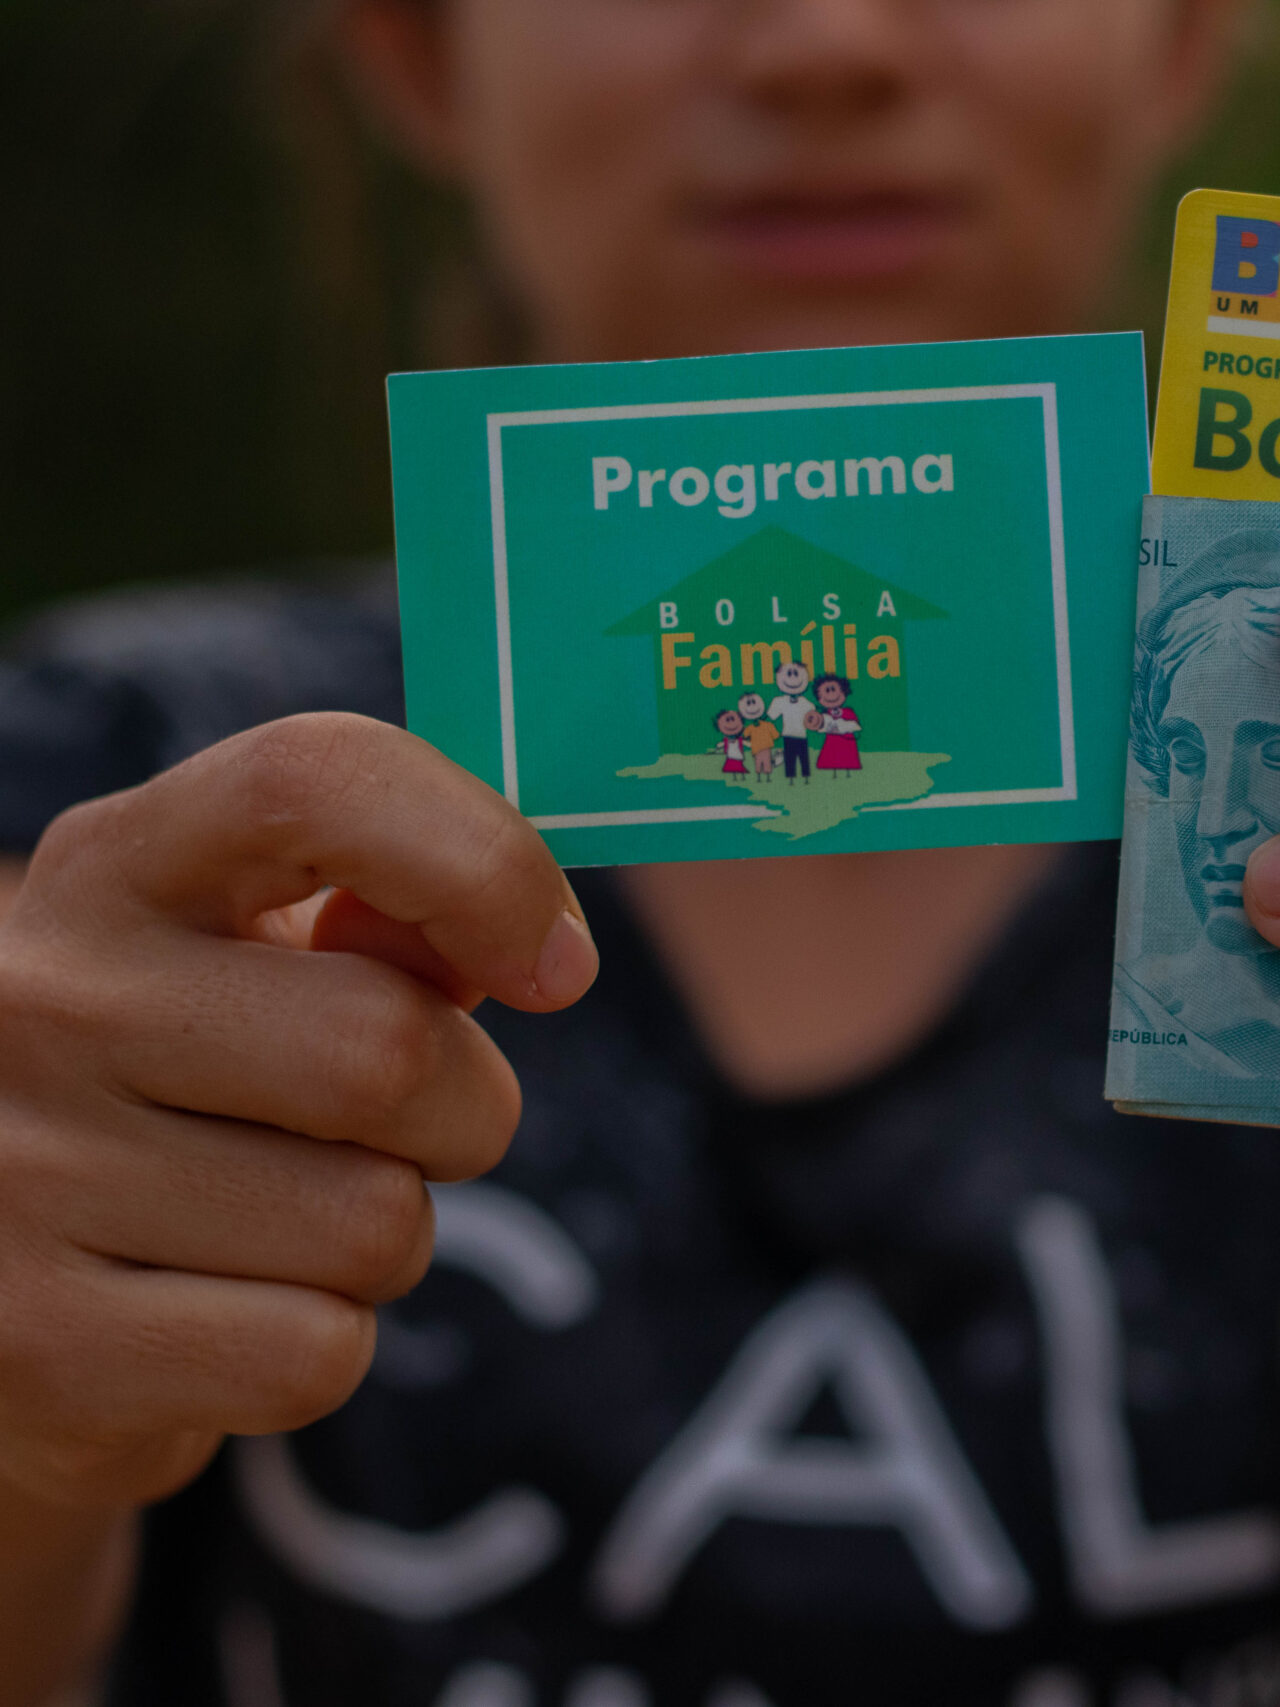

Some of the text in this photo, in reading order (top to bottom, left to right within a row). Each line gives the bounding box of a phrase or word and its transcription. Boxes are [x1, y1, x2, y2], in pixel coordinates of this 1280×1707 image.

[1216, 298, 1259, 315] UM
[591, 453, 955, 519] Programa
[1138, 538, 1178, 567] SIL
[658, 590, 897, 629] BOLSA
[660, 620, 901, 690] Família
[1107, 1028, 1188, 1046] EPÚBLICA
